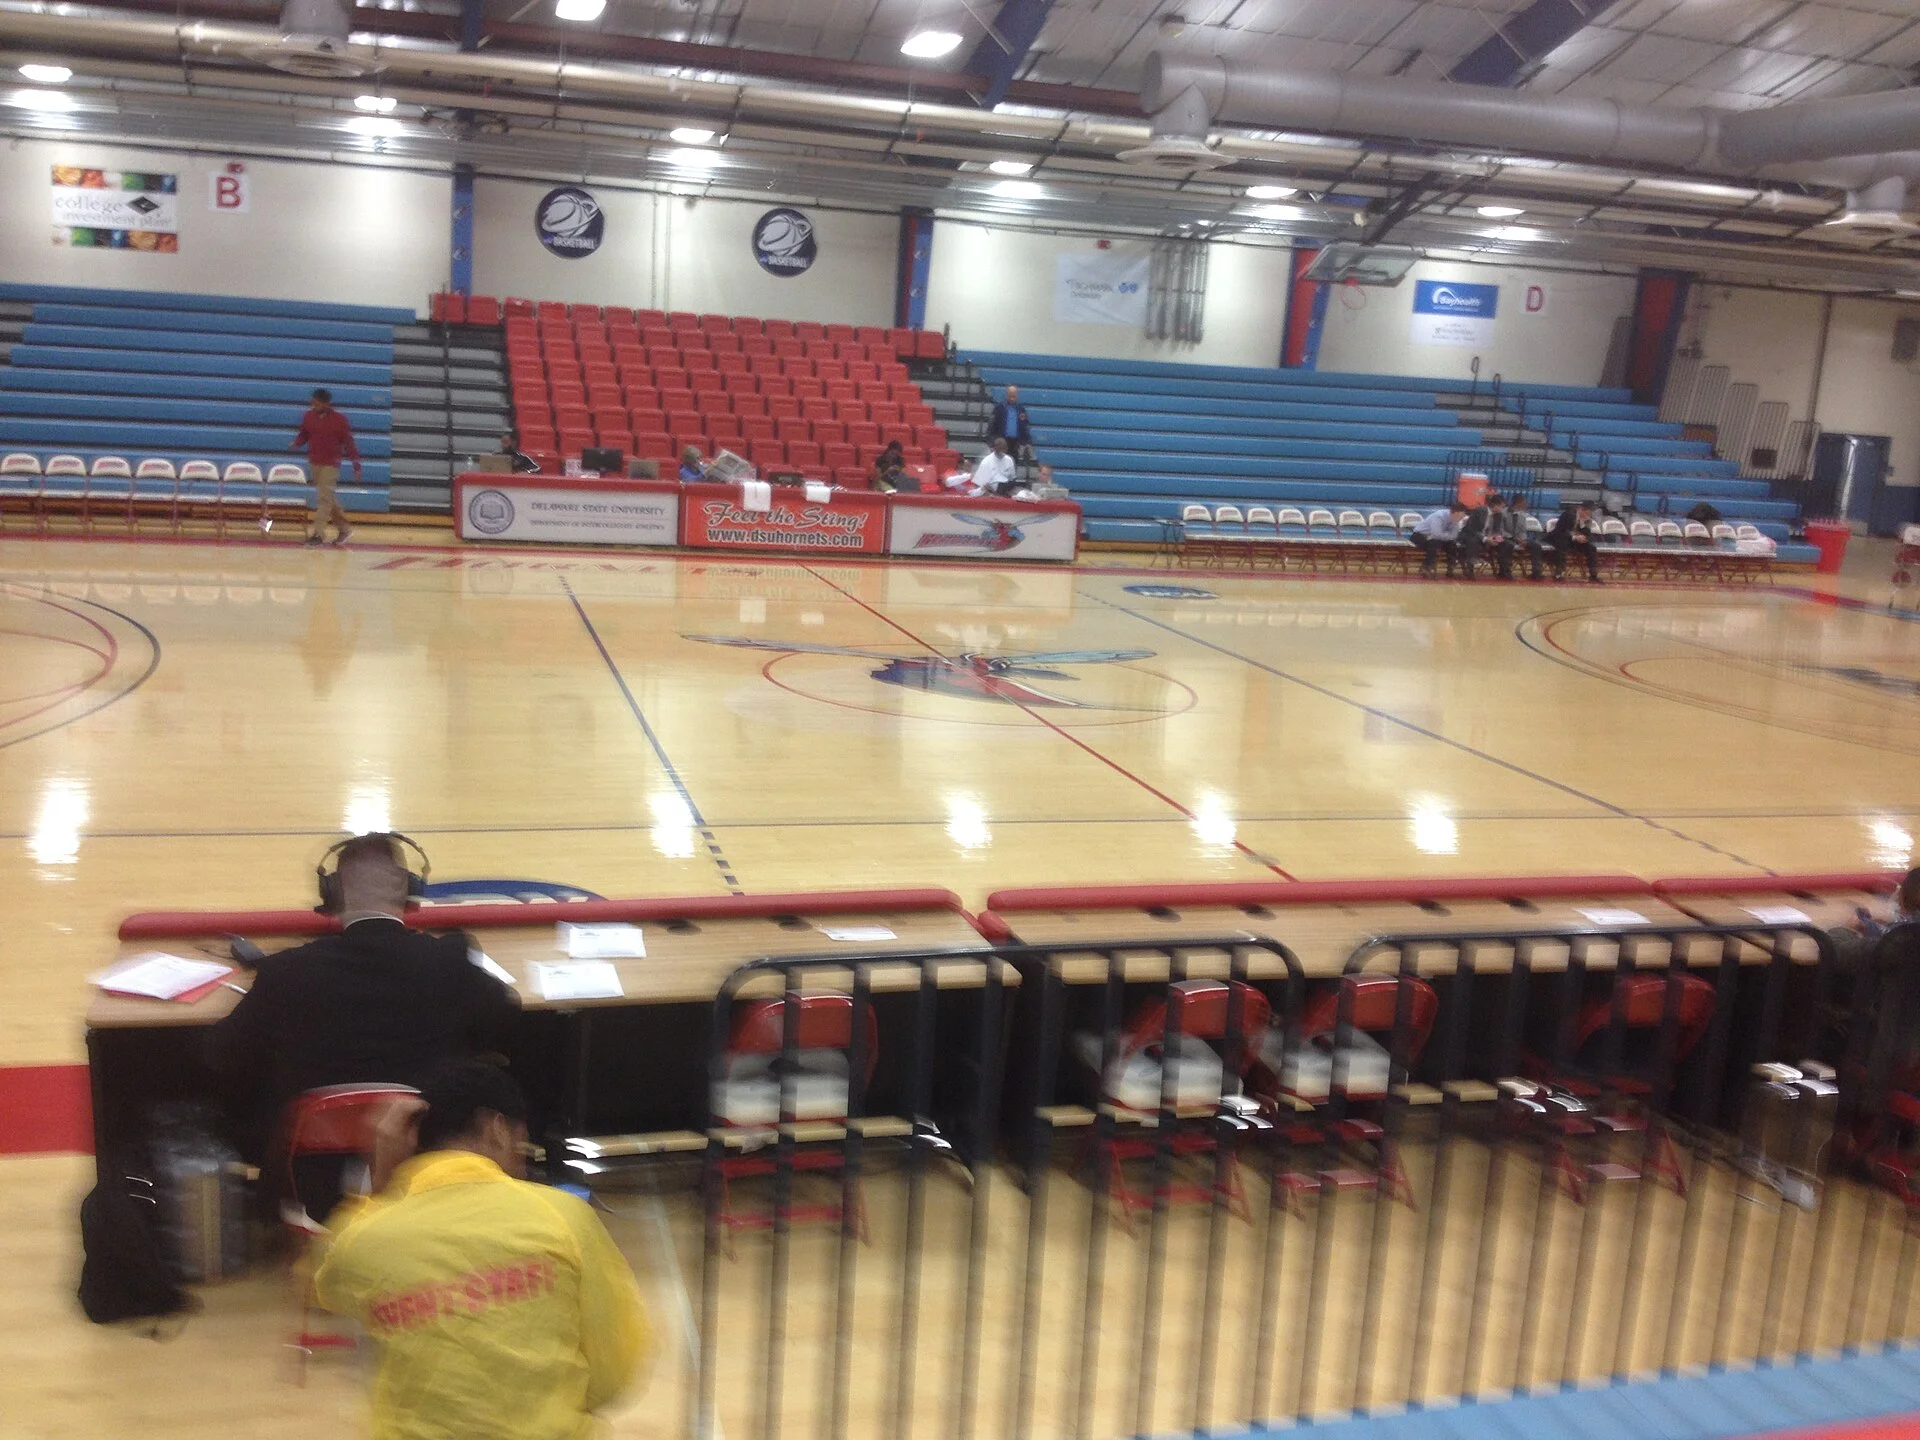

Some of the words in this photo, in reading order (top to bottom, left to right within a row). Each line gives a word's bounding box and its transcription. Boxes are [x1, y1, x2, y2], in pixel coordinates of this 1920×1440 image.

[216, 176, 241, 208] B
[55, 195, 123, 214] college
[553, 236, 595, 249] BASKETBALL
[768, 255, 807, 268] BASKETBALL
[1526, 285, 1544, 312] D
[531, 502, 579, 512] DELAWARE
[582, 504, 608, 513] STATE
[611, 505, 665, 516] UNIVERSITY
[764, 507, 795, 525] the
[794, 506, 868, 534] Sting!
[707, 528, 864, 548] www.dsuhornets.com
